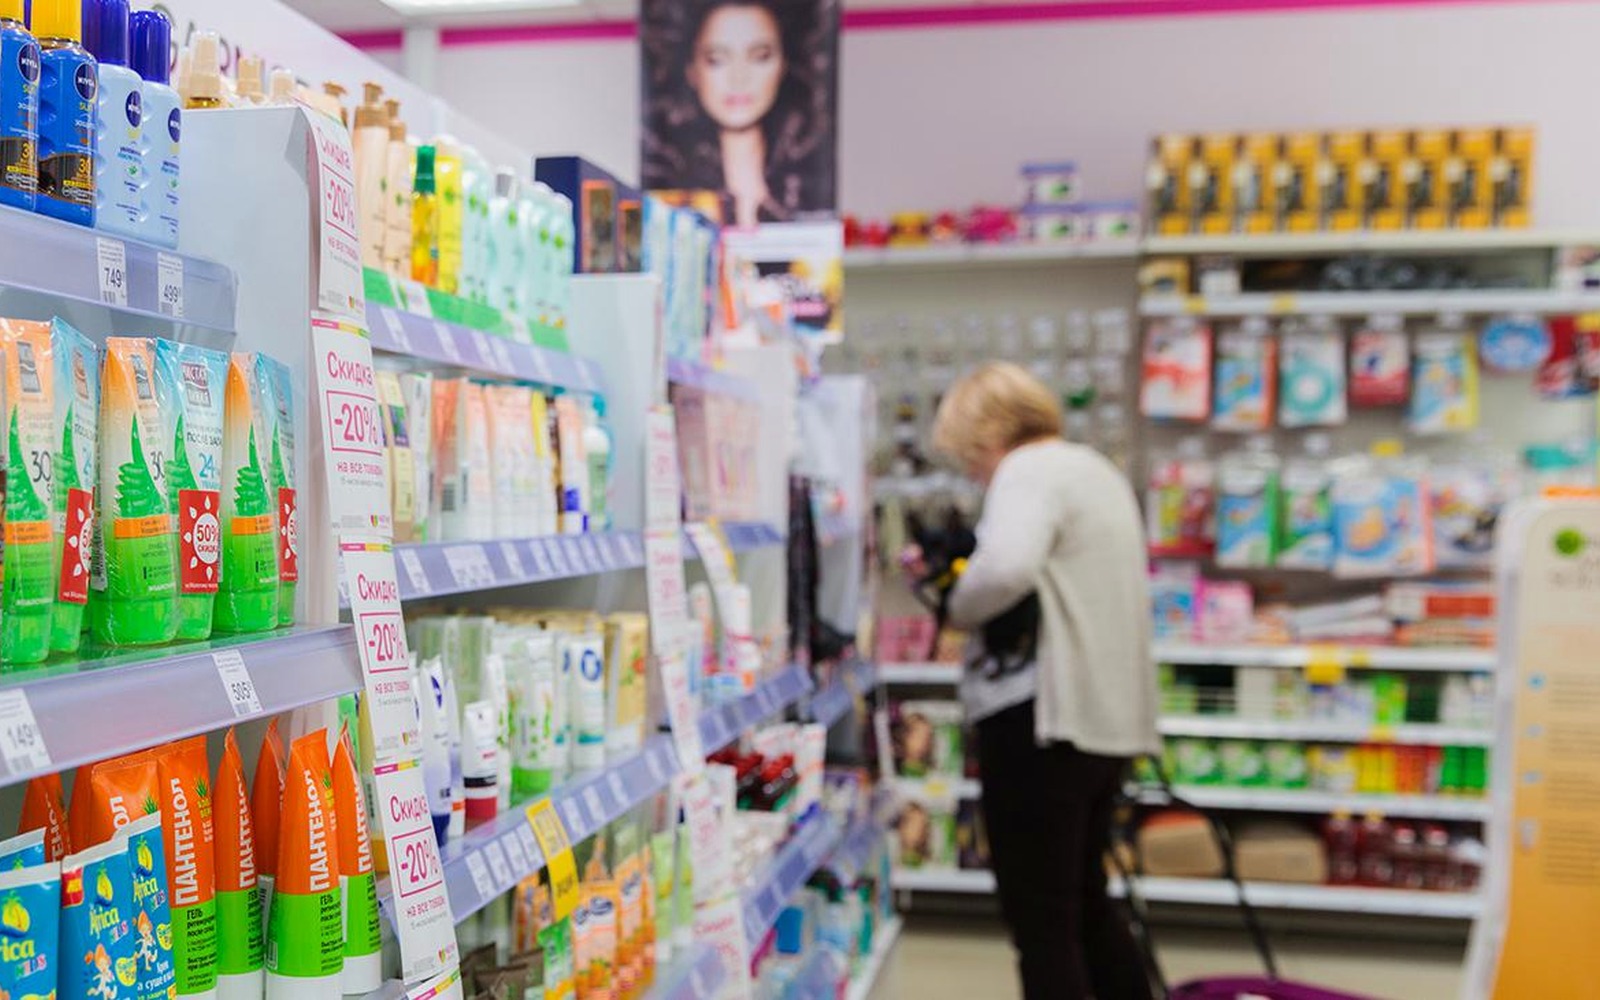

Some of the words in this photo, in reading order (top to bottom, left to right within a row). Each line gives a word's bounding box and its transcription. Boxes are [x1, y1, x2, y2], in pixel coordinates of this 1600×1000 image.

[104, 266, 122, 288] 749
[326, 350, 374, 387] Скидка
[334, 402, 379, 445] -20%
[31, 450, 50, 483] 30
[357, 573, 398, 604] Скидка
[368, 624, 406, 661] -20%
[390, 795, 428, 823] Скидка
[170, 777, 200, 906] ПАНТЕНОЛ
[303, 769, 331, 892] ПАНТЕНОЛ
[401, 839, 439, 884] -20%
[187, 907, 203, 921] ГЕЛЬ
